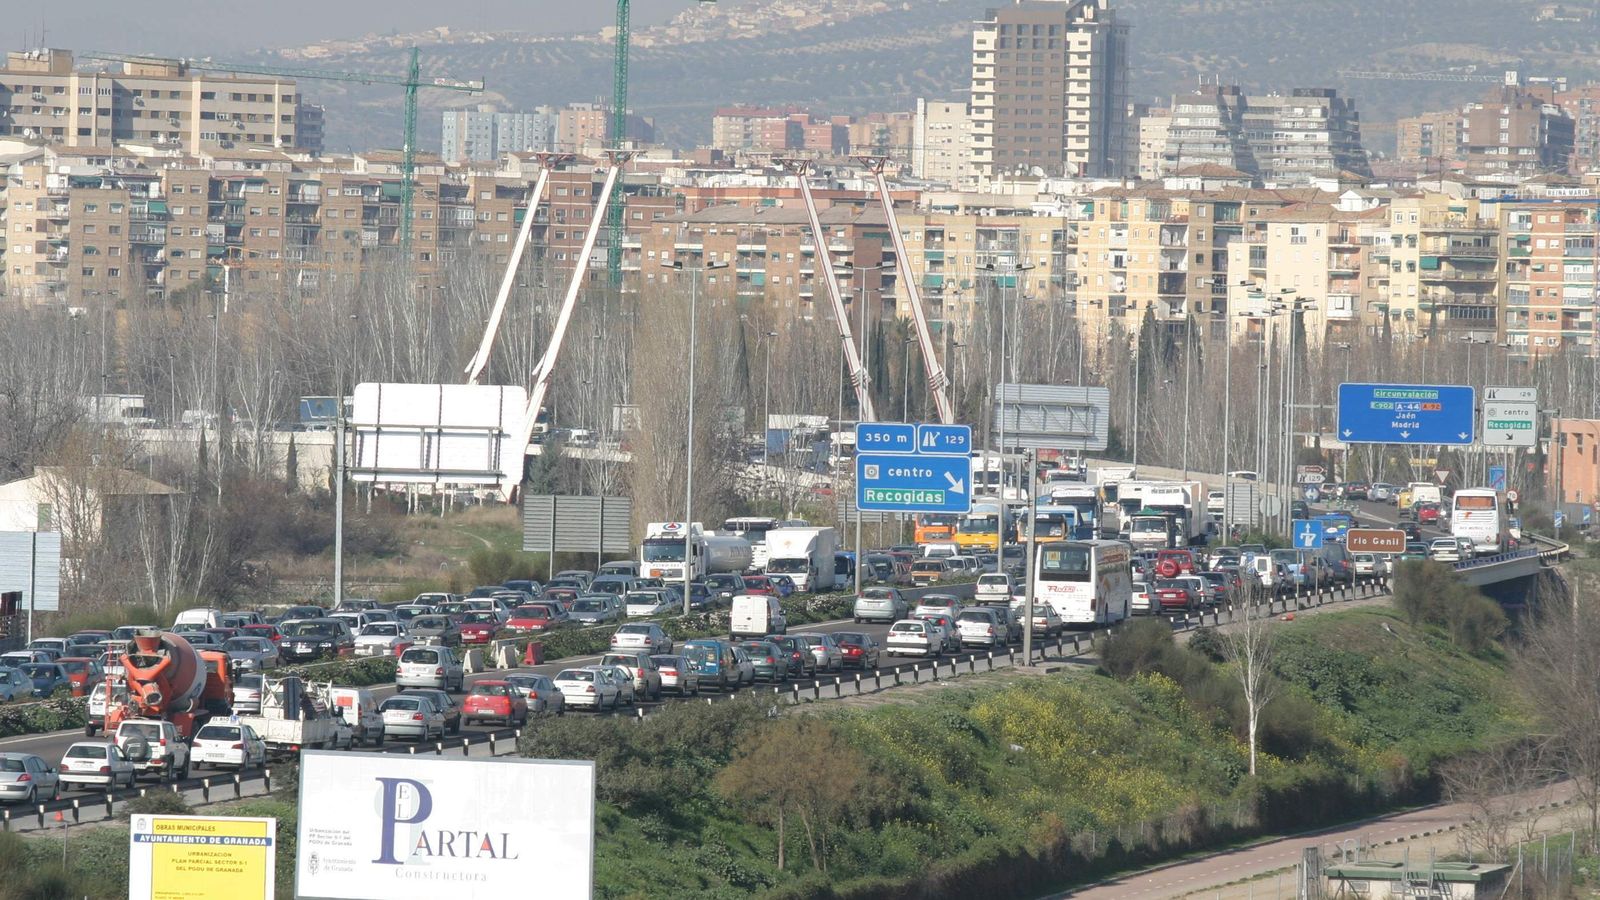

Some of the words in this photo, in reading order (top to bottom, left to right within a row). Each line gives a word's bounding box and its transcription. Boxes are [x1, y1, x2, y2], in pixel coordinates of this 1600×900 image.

[1396, 411, 1416, 420] Jaén
[1488, 421, 1531, 429] Recogidas
[865, 433, 890, 442] 350
[897, 435, 907, 443] m
[945, 435, 965, 444] 129
[888, 467, 933, 477] centro
[866, 489, 943, 505] Recogidas
[1372, 537, 1399, 545] Genil
[140, 834, 207, 844] AYUNTAMIENTO
[209, 836, 222, 844] DE
[224, 837, 267, 846] GRANADA
[395, 867, 488, 882] Constructora
